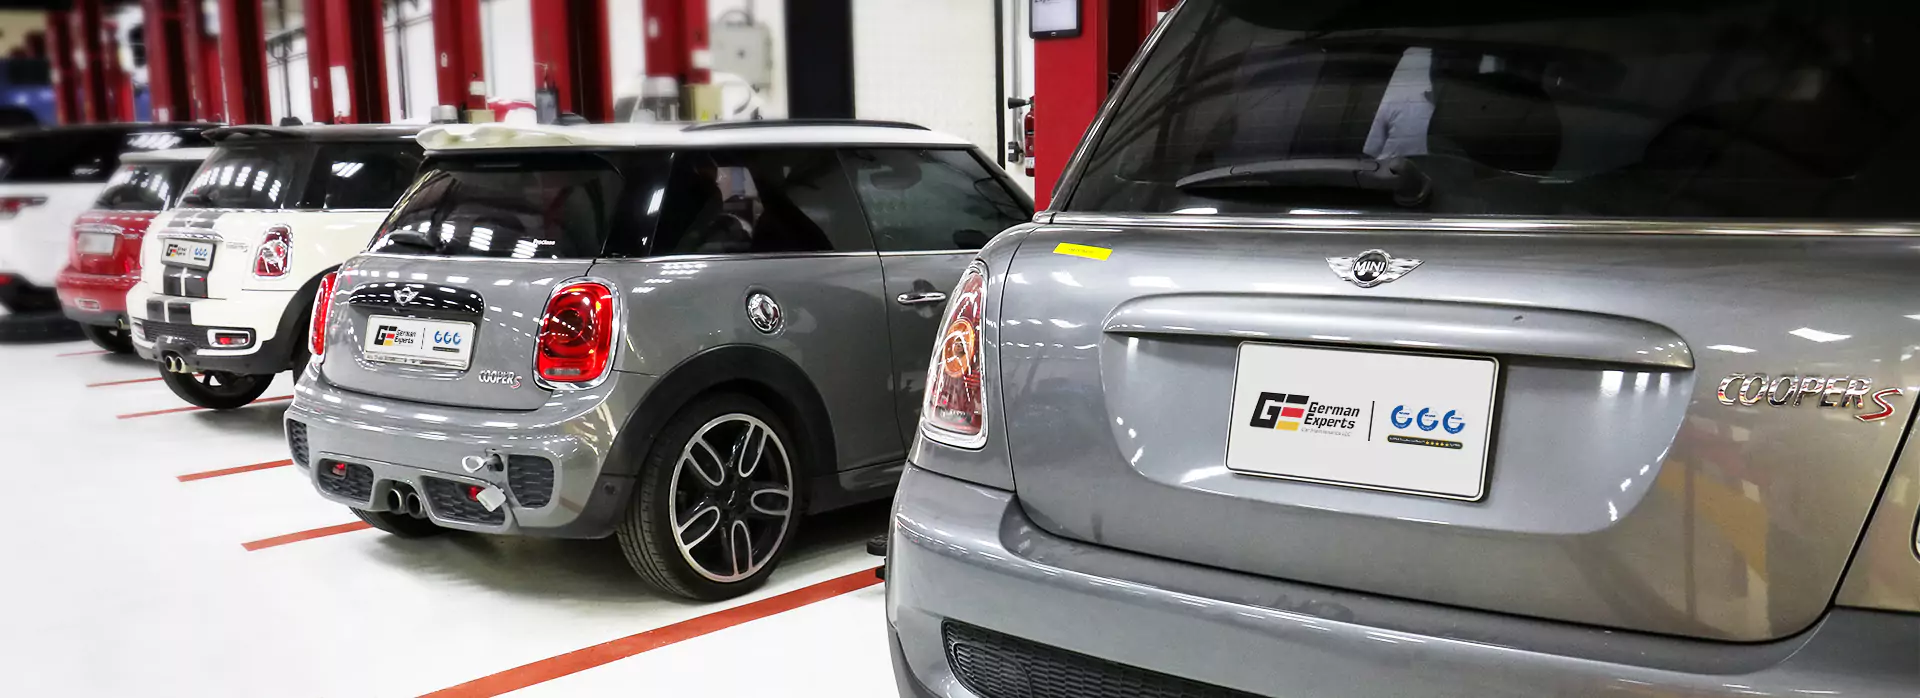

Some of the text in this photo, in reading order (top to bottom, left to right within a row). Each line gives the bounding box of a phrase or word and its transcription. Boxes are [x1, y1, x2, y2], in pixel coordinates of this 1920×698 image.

[1354, 261, 1385, 272] MINI
[478, 370, 515, 385] COOPER
[1717, 373, 1904, 422] COOPER S
[1308, 401, 1360, 417] German
[1303, 413, 1356, 429] Experts
